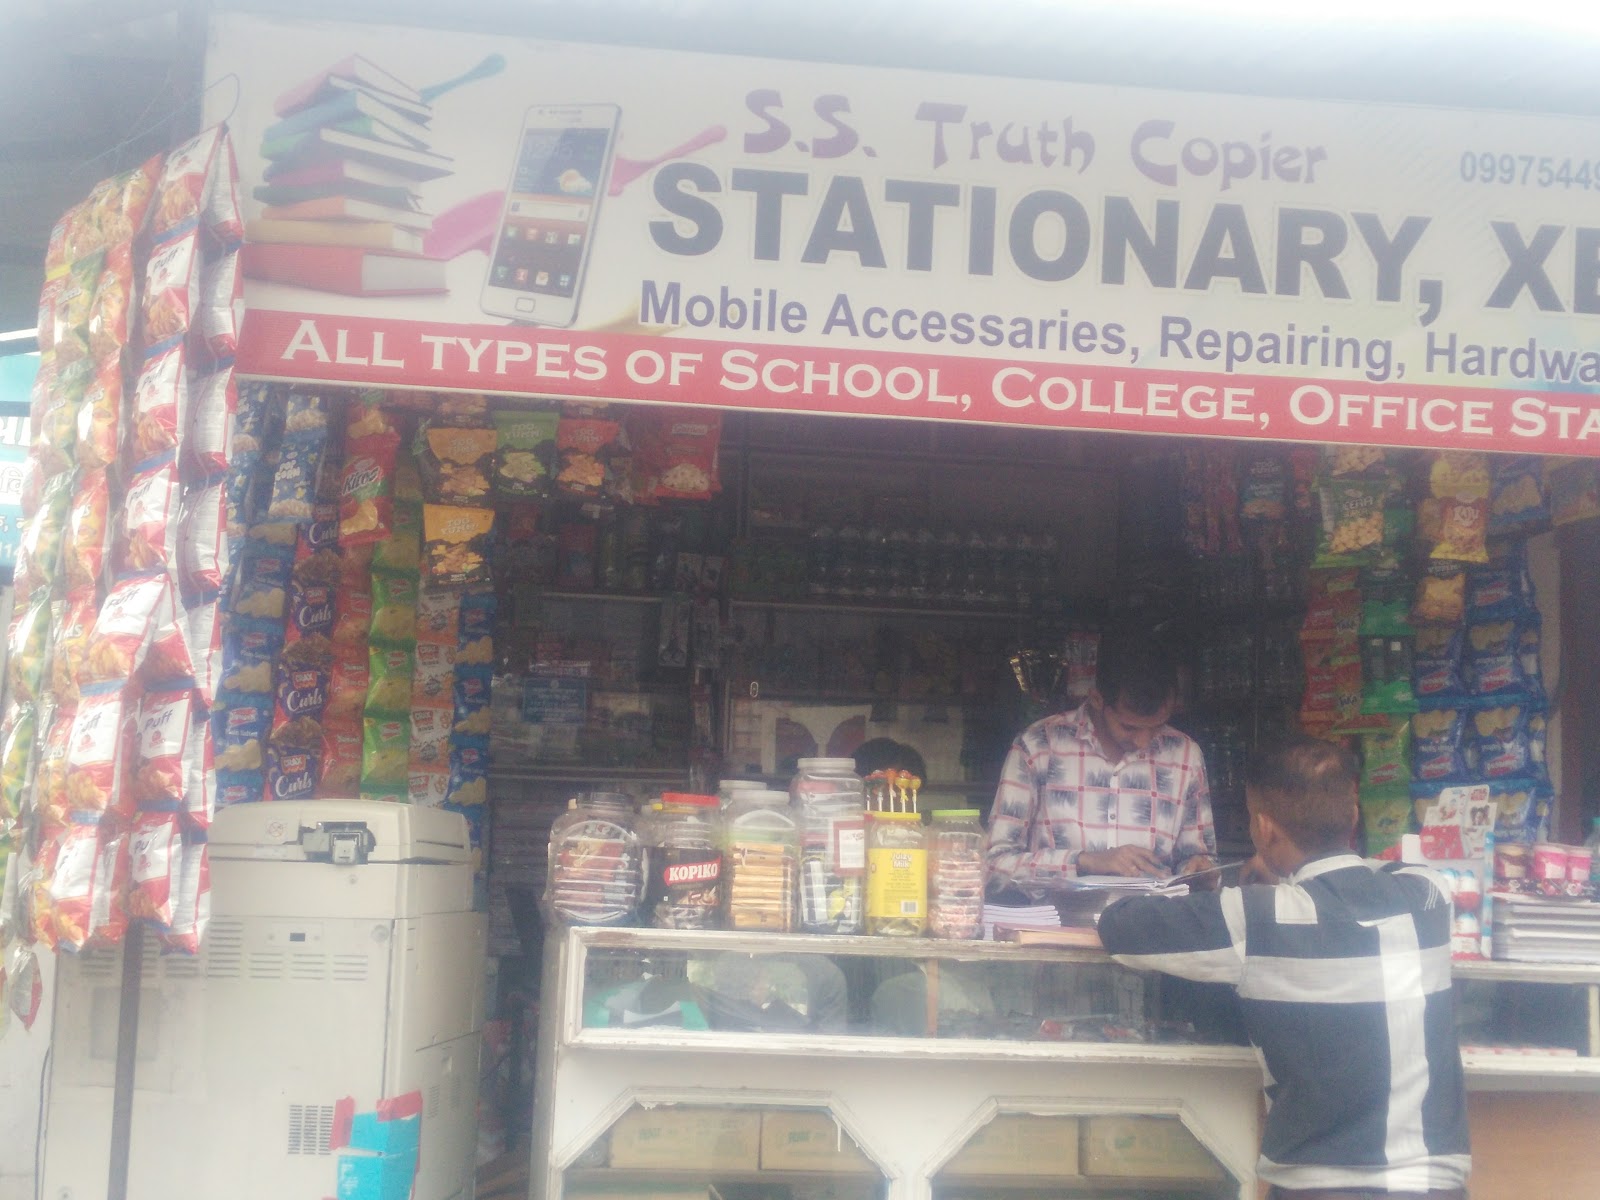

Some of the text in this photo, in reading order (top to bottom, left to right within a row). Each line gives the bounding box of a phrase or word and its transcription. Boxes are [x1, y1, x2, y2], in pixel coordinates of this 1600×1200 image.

[743, 89, 1327, 192] S.S. Truth Copier
[648, 161, 1442, 327] STATIONARY,
[639, 279, 1600, 383] Mobile Accessaries, Repairing, Hardwa
[282, 320, 404, 369] ALL
[421, 333, 607, 384] TYPES
[624, 349, 701, 388] OF
[719, 350, 971, 412] SCHOOL,
[992, 366, 1269, 431] COLLEGE,
[1290, 384, 1492, 435] OFFICE
[299, 604, 331, 627] Curls
[287, 687, 322, 712] Curls
[144, 709, 173, 732] Puff
[275, 770, 312, 797] Curls
[669, 863, 718, 881] KOPIKO
